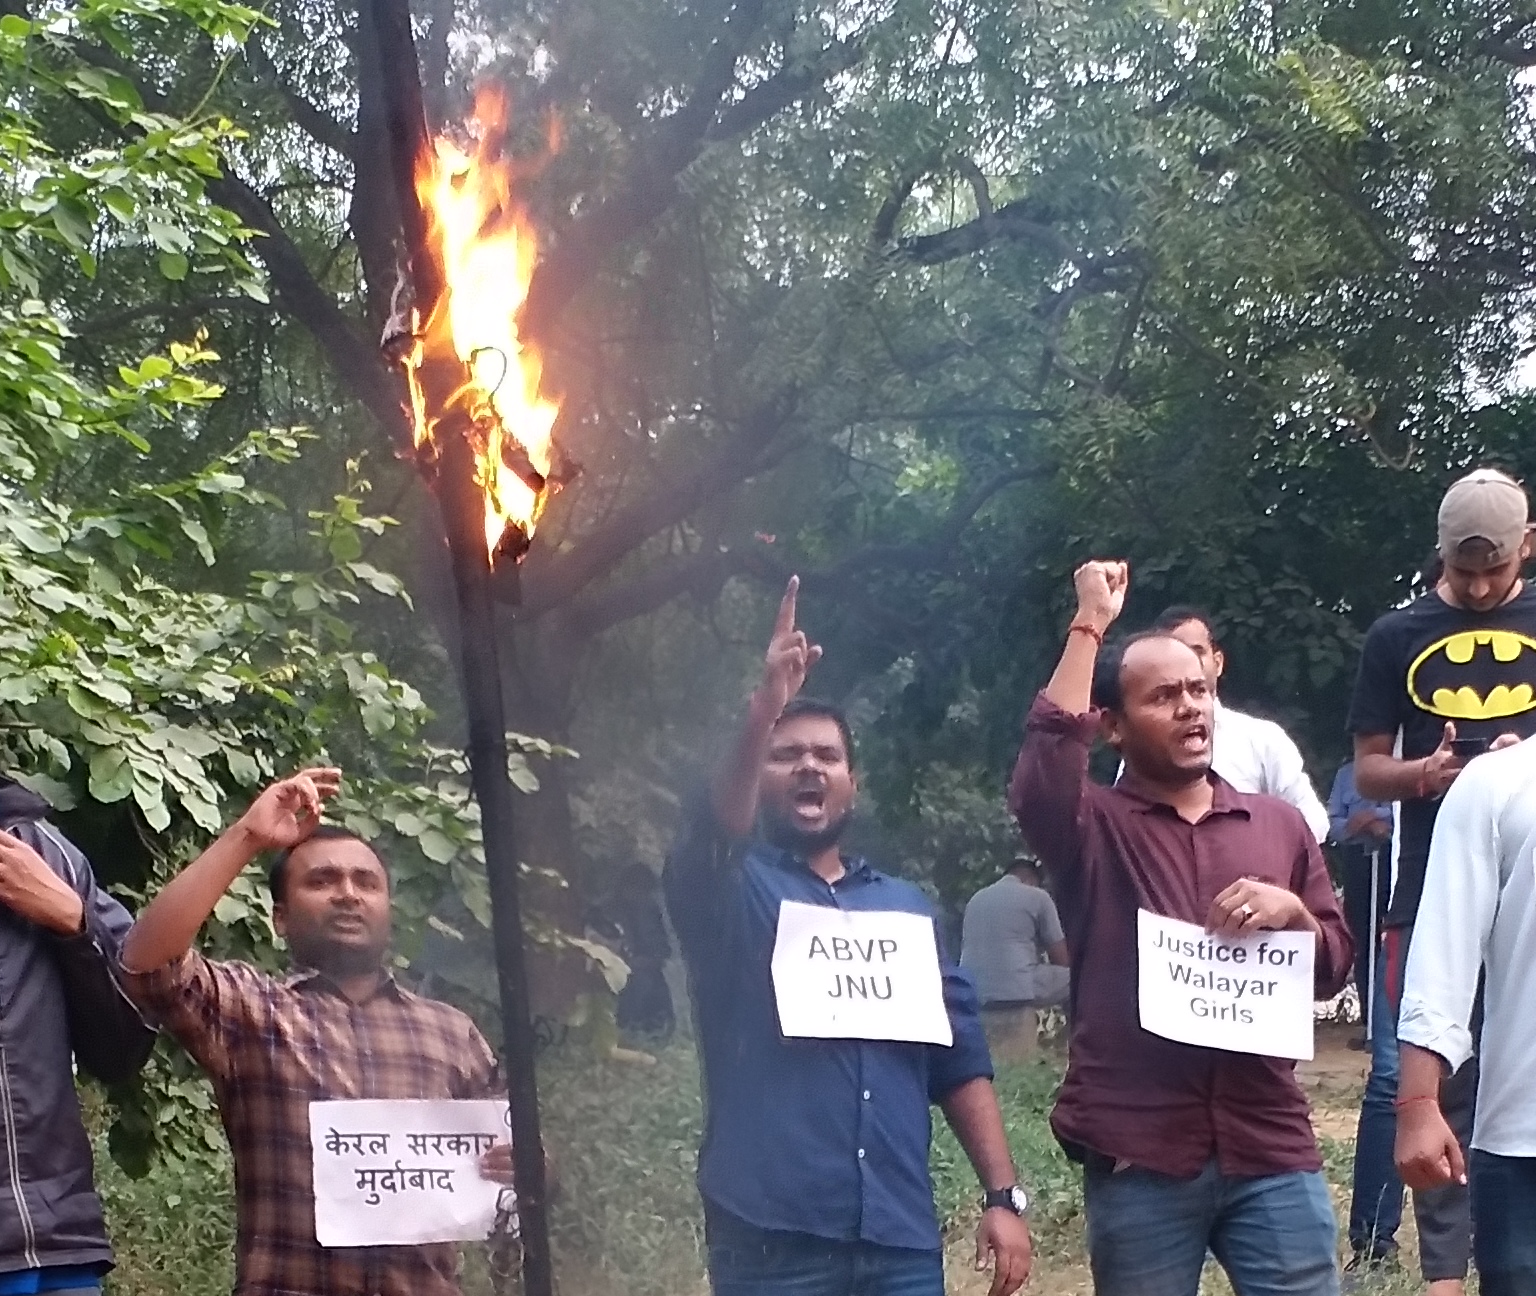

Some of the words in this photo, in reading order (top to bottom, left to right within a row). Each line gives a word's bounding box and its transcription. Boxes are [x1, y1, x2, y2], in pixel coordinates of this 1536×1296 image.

[808, 935, 898, 963] ABVP
[1153, 930, 1247, 964] Justice
[1257, 942, 1300, 967] for
[827, 974, 893, 1000] JNU
[1168, 961, 1279, 999] Walayar
[1190, 997, 1254, 1024] Girls
[325, 1127, 391, 1156] केरल
[405, 1133, 498, 1157] सरकार
[354, 1159, 455, 1205] मुर्दाबाद
